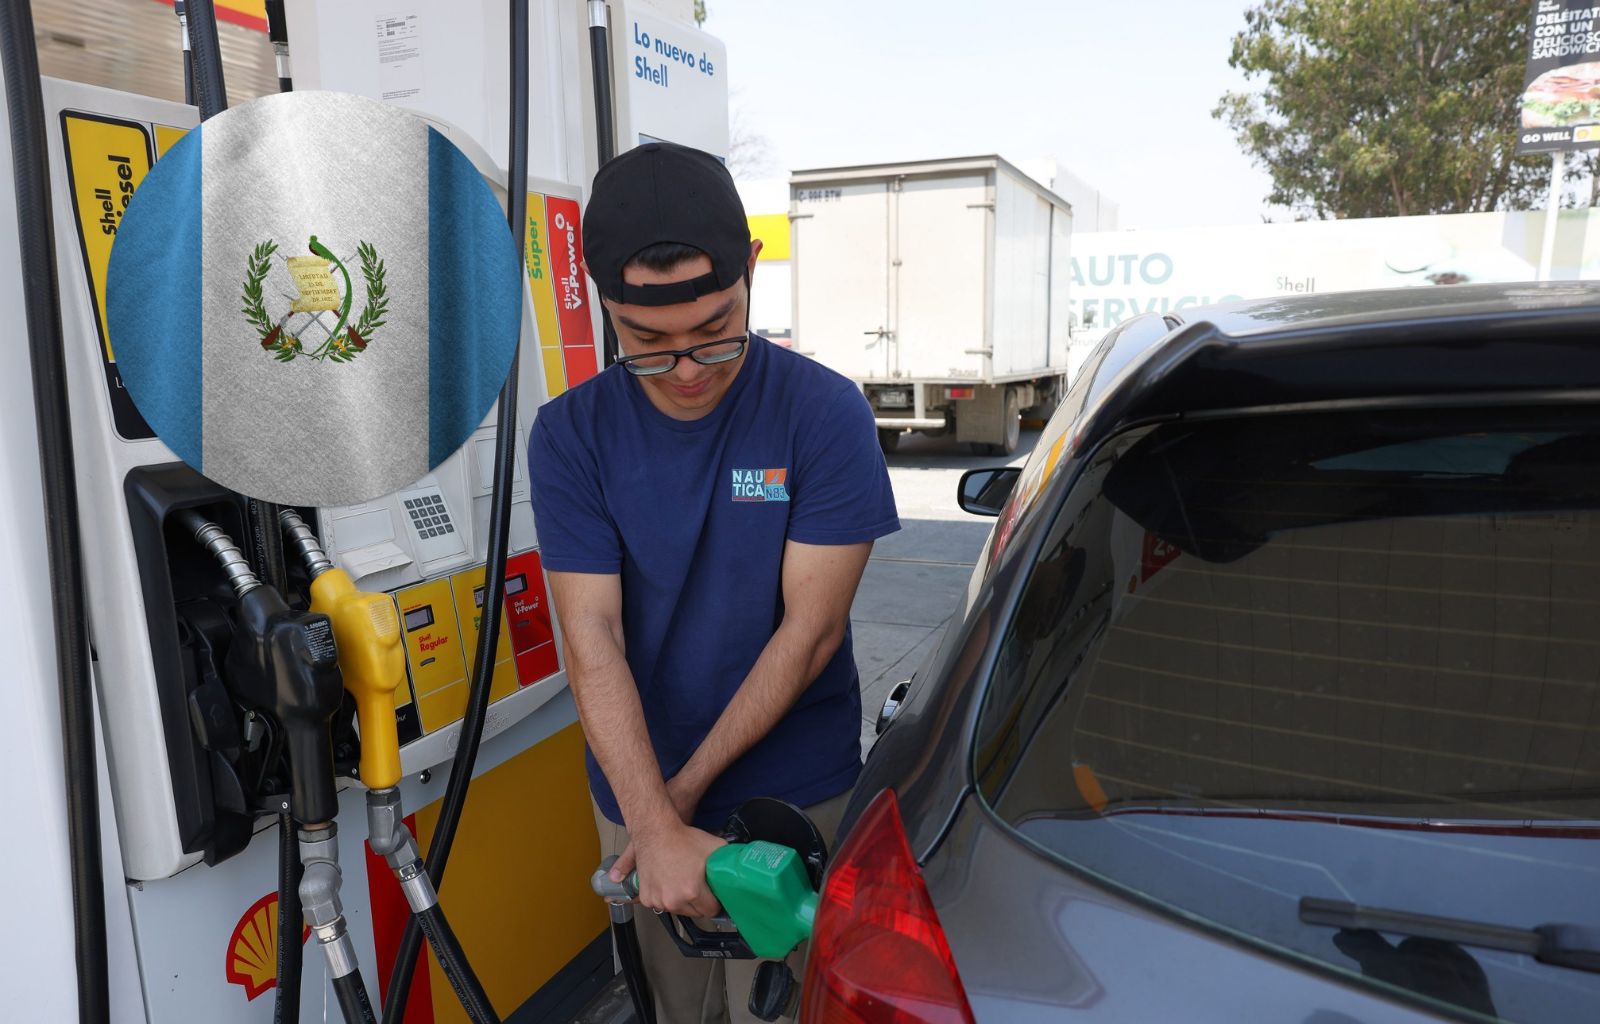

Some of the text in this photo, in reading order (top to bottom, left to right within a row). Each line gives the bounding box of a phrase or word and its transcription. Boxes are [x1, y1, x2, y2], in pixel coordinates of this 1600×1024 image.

[1534, 20, 1593, 37] CON UN
[1536, 7, 1600, 26] DELÉITAT
[634, 22, 714, 76] Lo nuevo de
[635, 55, 668, 88] Shell
[1522, 131, 1571, 144] GO WELL
[94, 188, 118, 236] Shell
[529, 216, 543, 280] Super
[566, 221, 582, 310] V-Power
[561, 277, 573, 310] Shell
[1276, 277, 1316, 293] Shell
[1069, 296, 1245, 329] SERVIC
[732, 470, 764, 484] NAU
[732, 483, 765, 497] TICA
[420, 636, 449, 653] Regular
